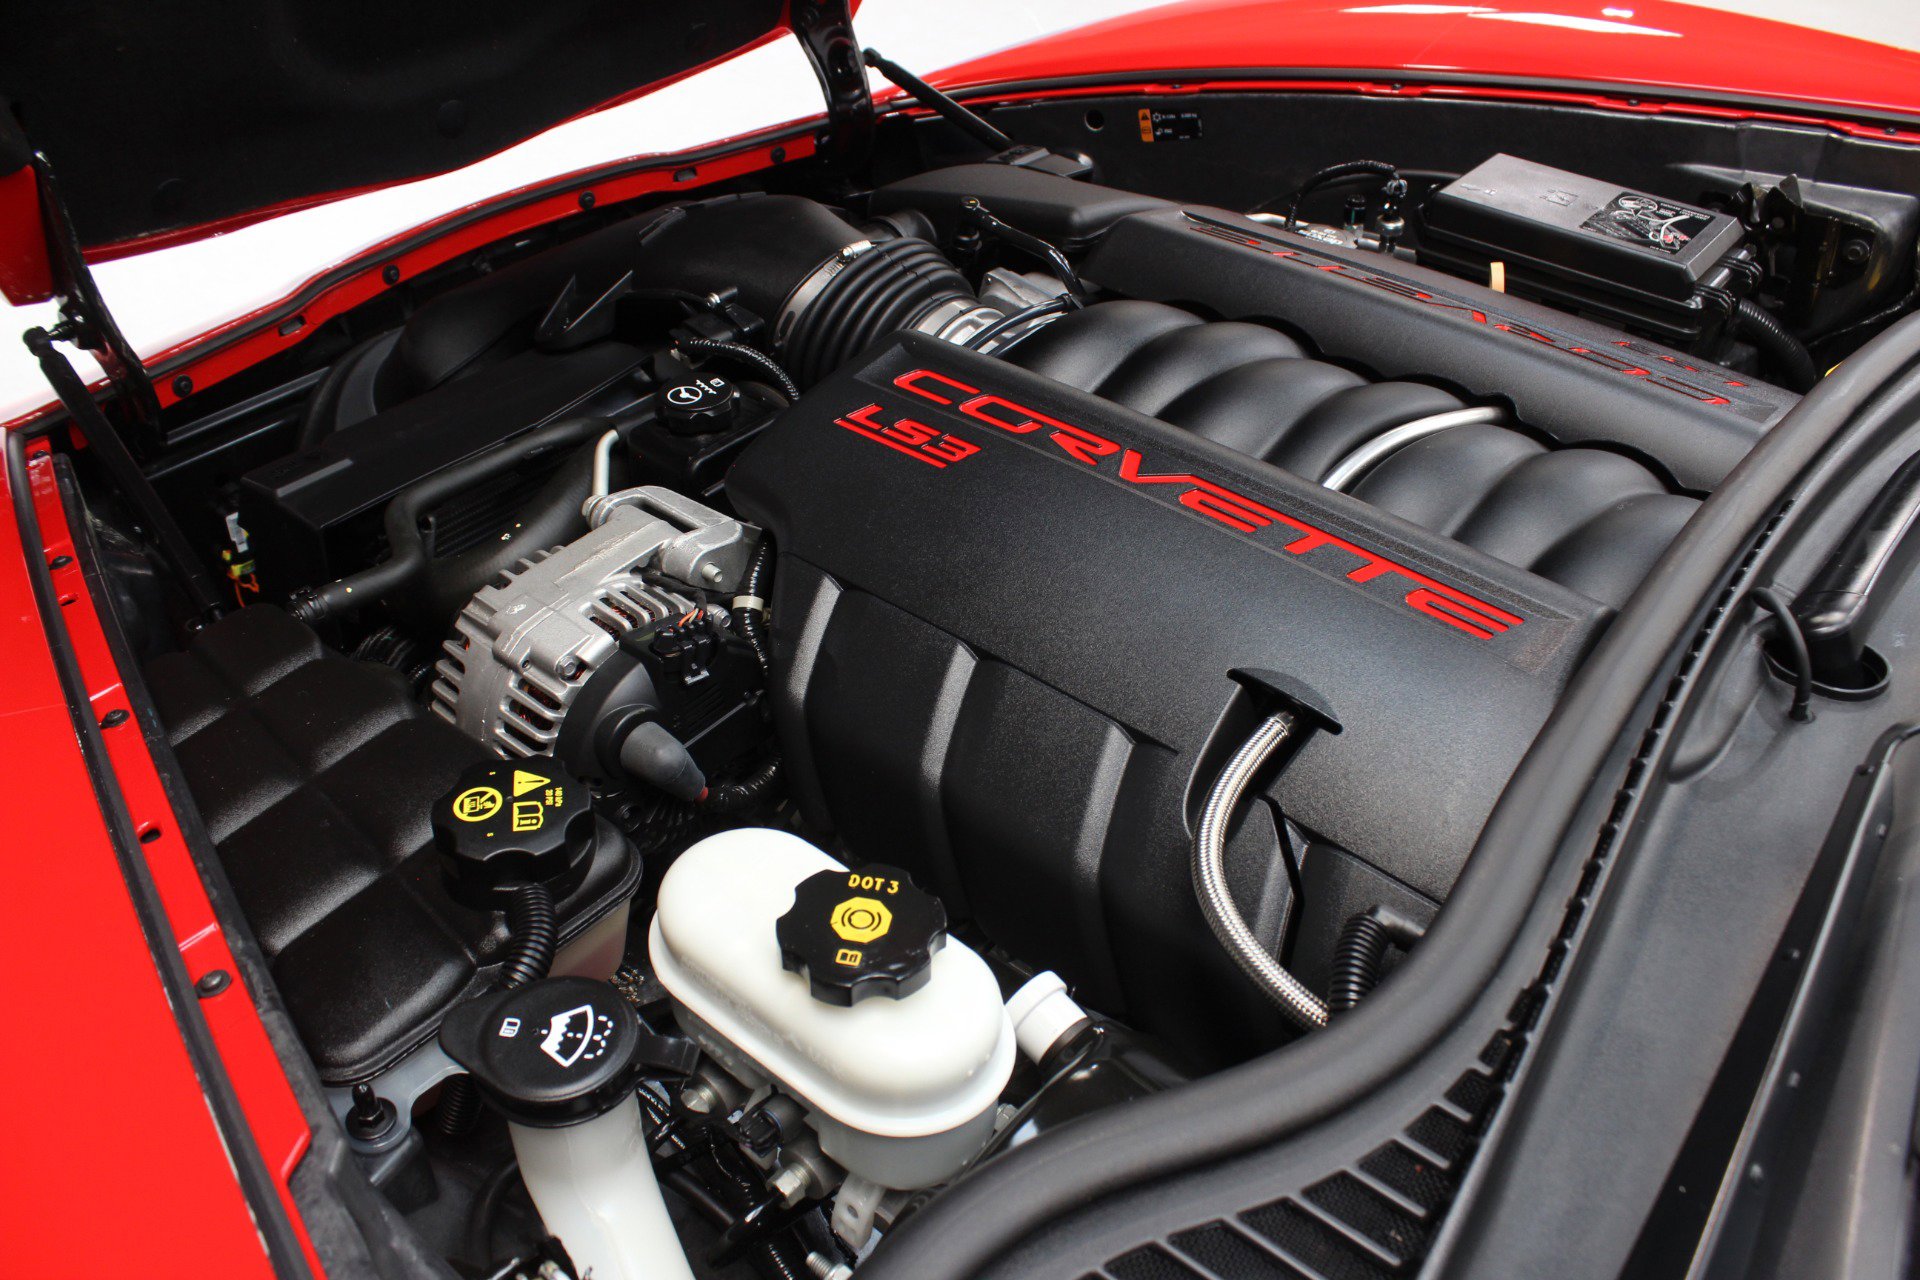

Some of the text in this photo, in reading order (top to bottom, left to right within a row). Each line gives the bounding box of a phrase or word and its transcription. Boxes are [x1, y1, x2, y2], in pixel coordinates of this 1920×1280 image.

[838, 403, 982, 466] LS3
[893, 369, 1525, 640] CORVETTE
[848, 874, 899, 894] DOT 3
